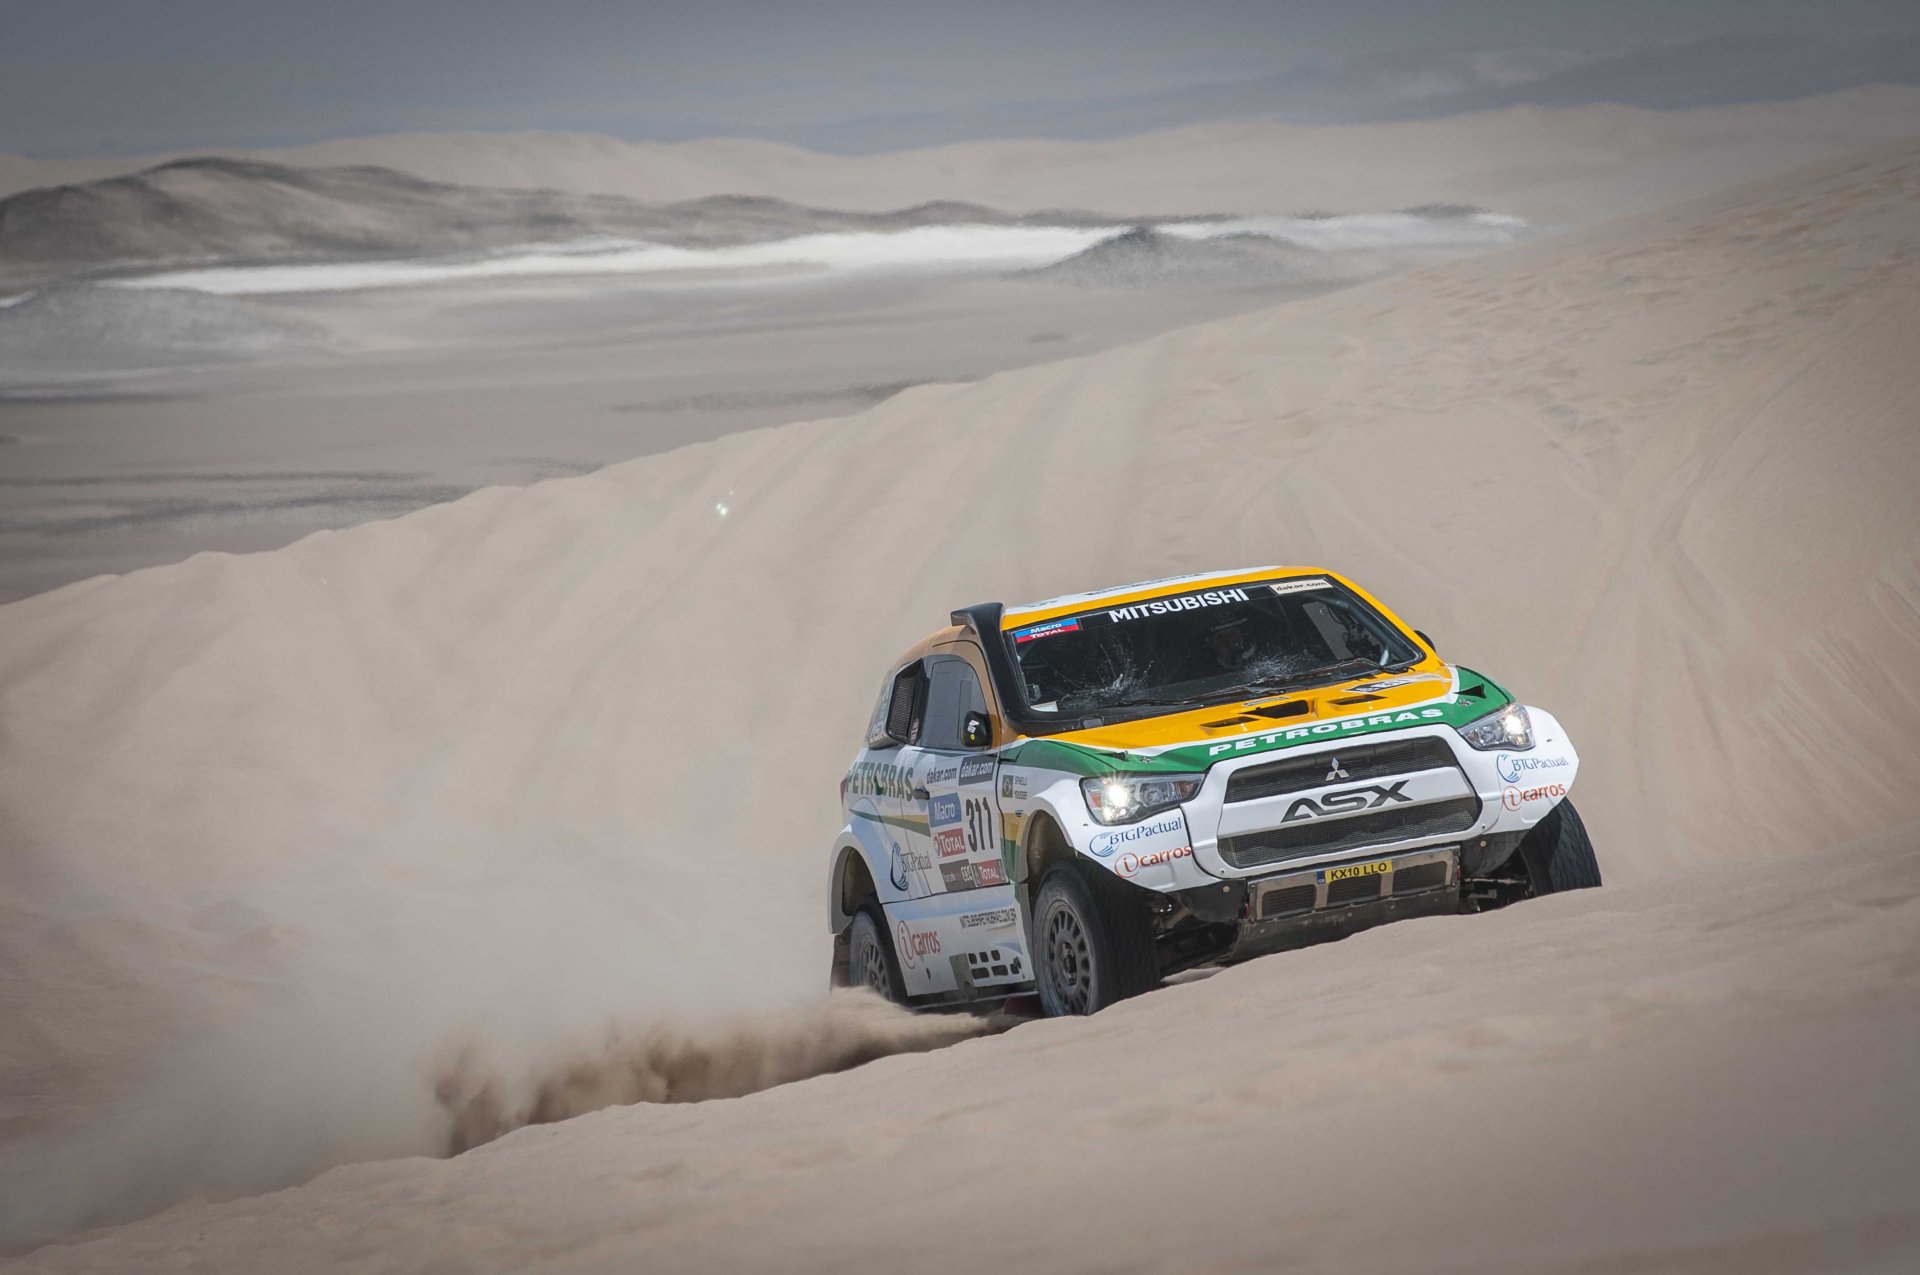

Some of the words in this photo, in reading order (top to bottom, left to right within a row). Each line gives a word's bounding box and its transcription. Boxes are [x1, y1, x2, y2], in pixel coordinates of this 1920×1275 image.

[1276, 581, 1327, 592] dakar.com
[1108, 588, 1250, 623] MITSUBISHI
[1029, 628, 1065, 639] TOTAL
[1030, 622, 1063, 634] Macro
[1209, 708, 1444, 756] PETROBRAS
[926, 766, 957, 785] dakar.com
[960, 761, 994, 778] dakar.com
[846, 761, 914, 802] PETROBRAS
[1280, 779, 1414, 824] ASX
[934, 802, 955, 821] Macro
[965, 796, 995, 853] 311
[940, 834, 965, 852] TOTAL
[978, 866, 1000, 881] TOTAL
[1330, 867, 1360, 881] KX10
[1363, 862, 1387, 875] LLO
